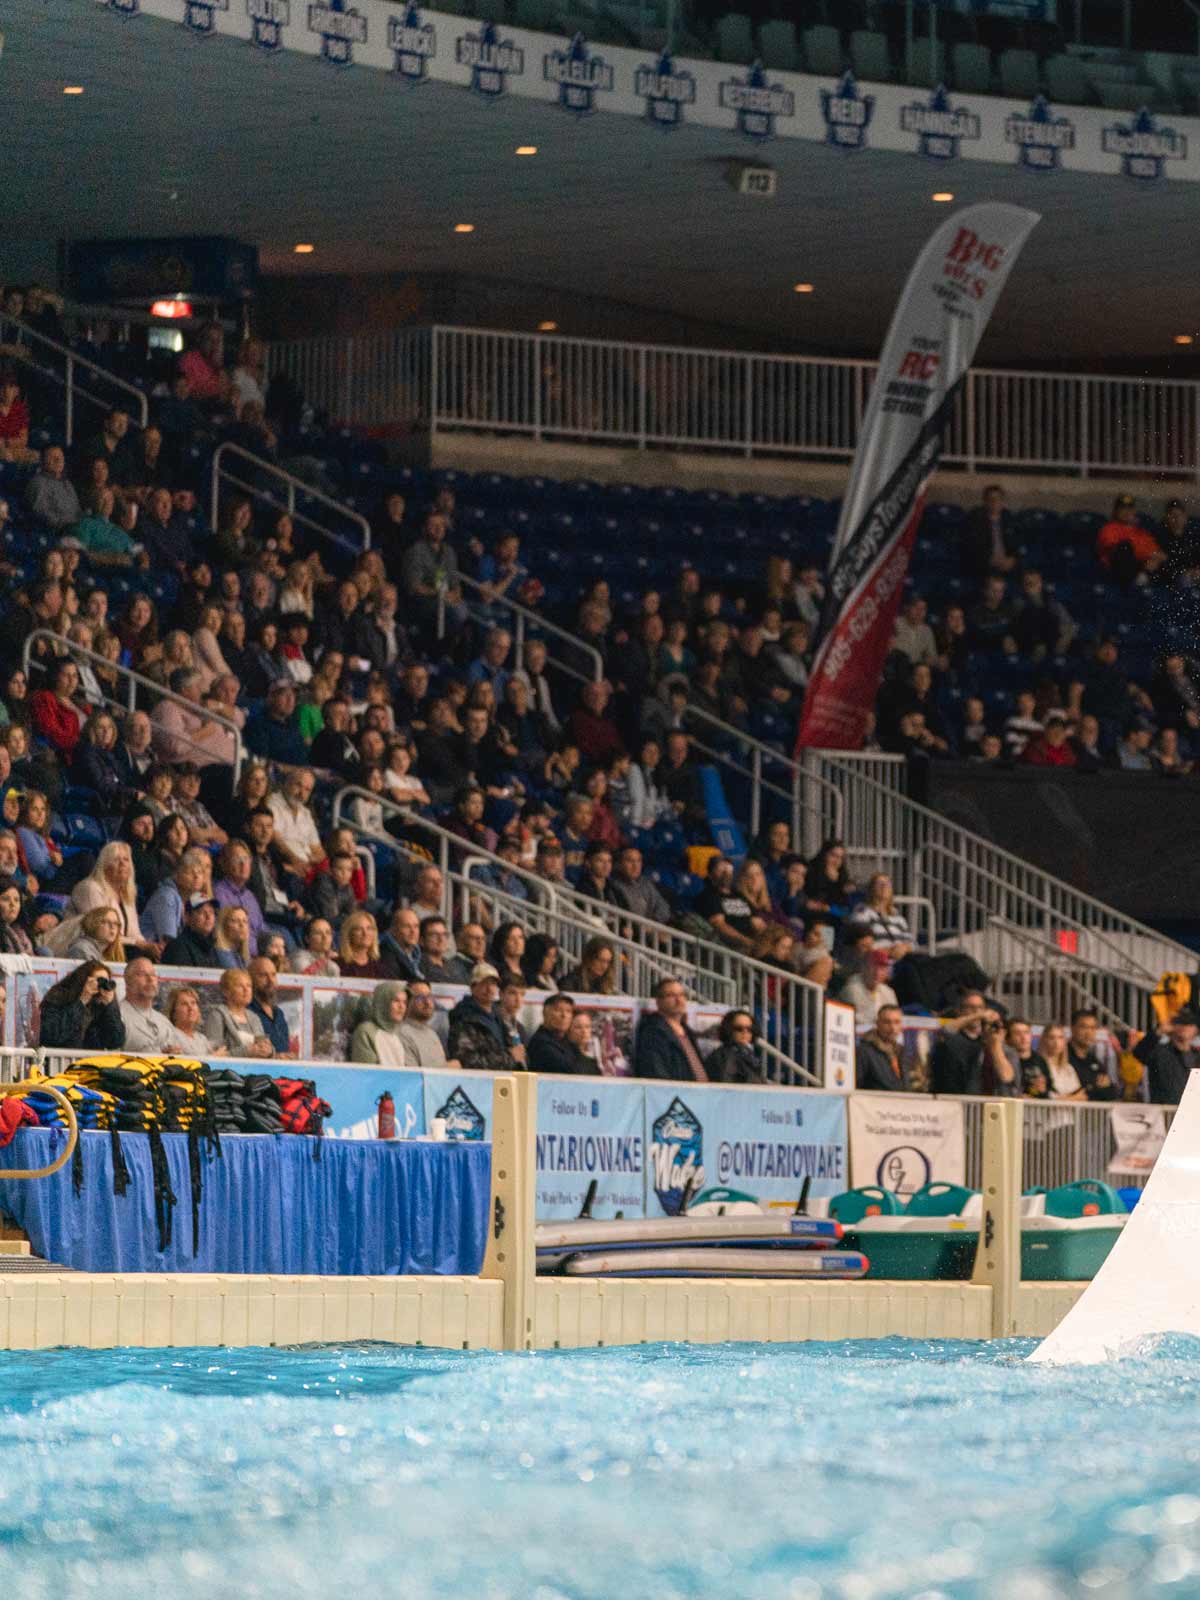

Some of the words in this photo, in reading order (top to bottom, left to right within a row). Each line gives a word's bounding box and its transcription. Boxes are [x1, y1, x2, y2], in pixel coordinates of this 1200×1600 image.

[899, 352, 941, 381] RC
[552, 1100, 576, 1115] Follow
[761, 1108, 784, 1122] Follow
[717, 1141, 843, 1184] @ONTARIOWAKE
